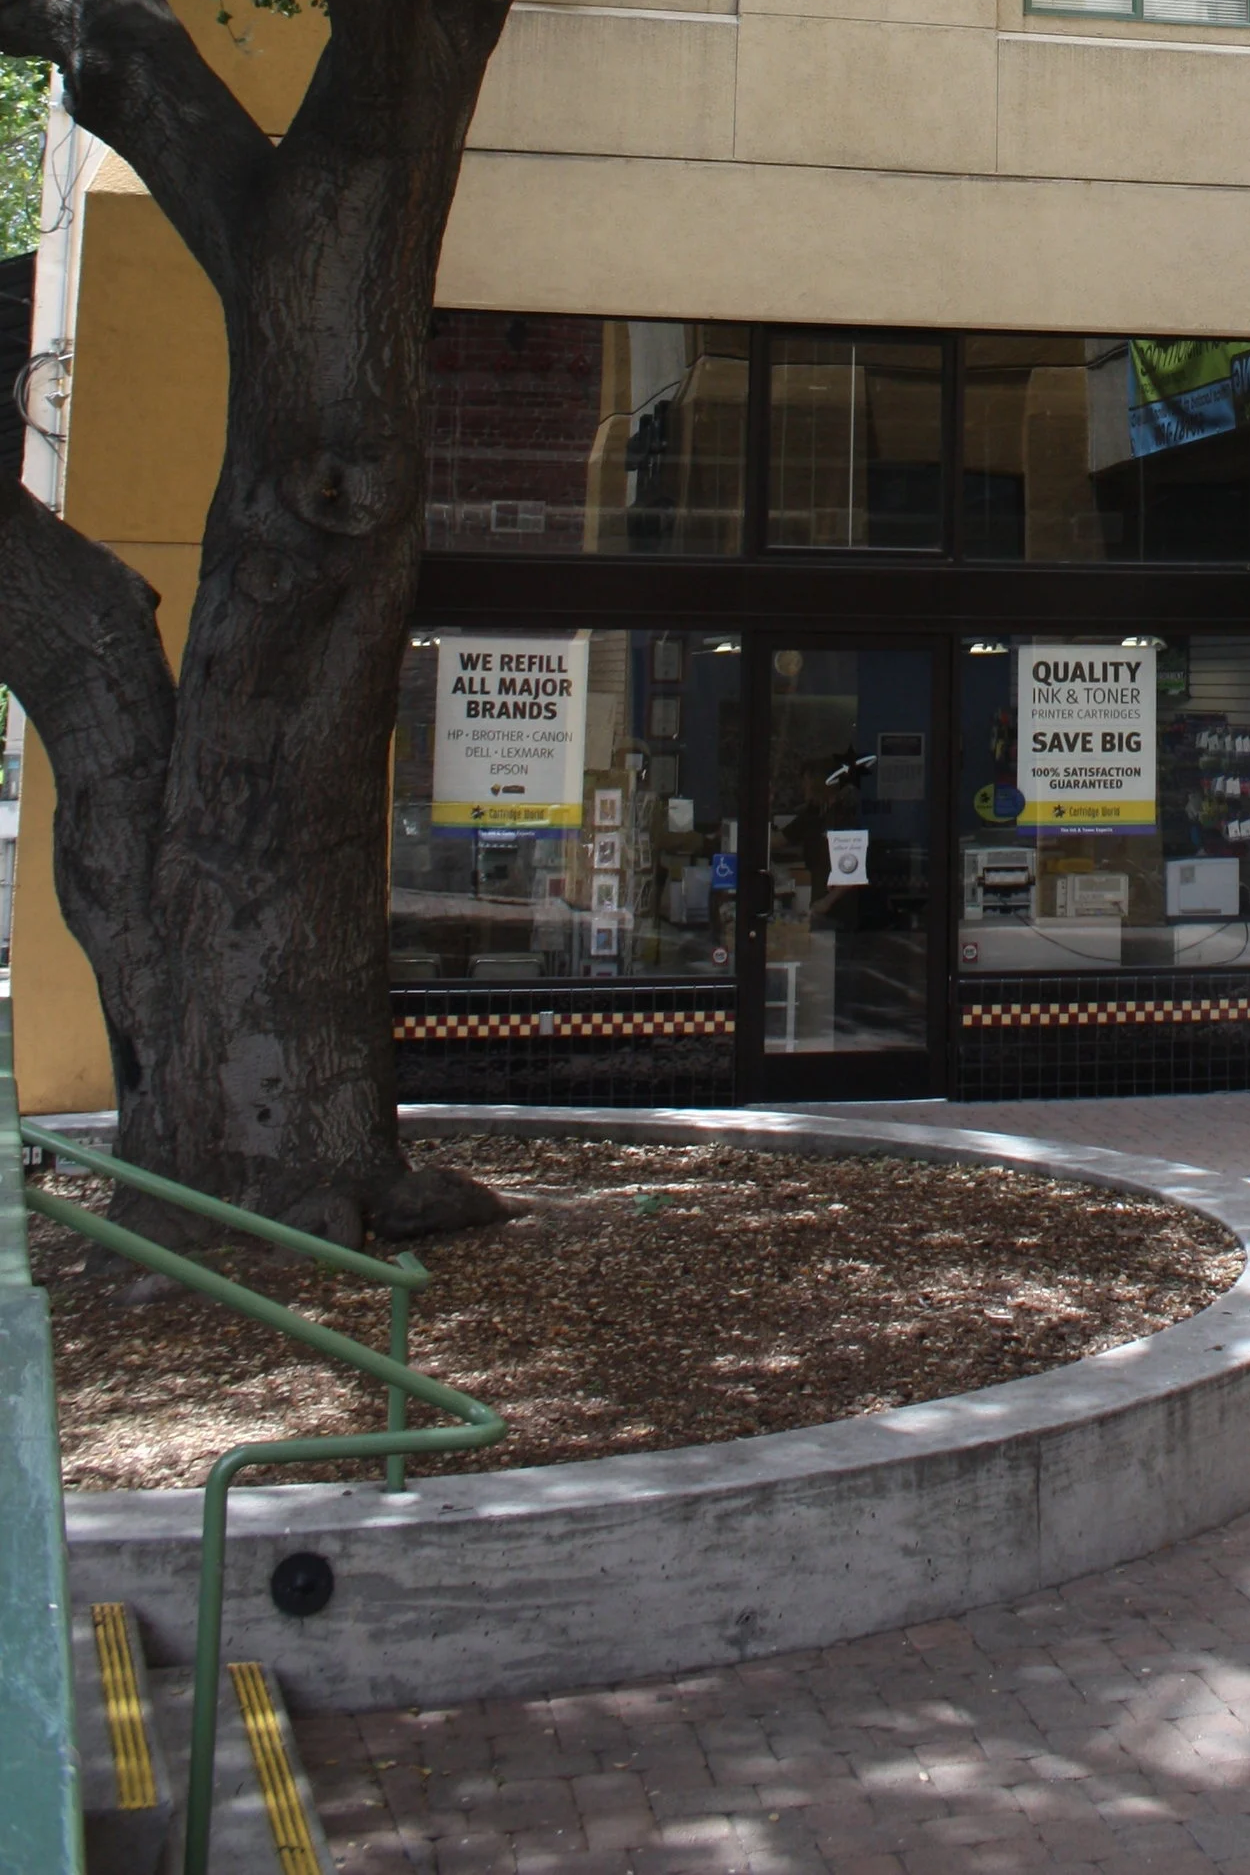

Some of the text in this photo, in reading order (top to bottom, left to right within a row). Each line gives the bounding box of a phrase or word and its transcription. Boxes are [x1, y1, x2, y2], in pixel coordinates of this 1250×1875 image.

[459, 652, 568, 673] WE REFILL
[1032, 660, 1142, 686] QUALITY
[451, 675, 573, 701] ALL MAJOR
[1032, 687, 1141, 704] INK & TONER
[466, 700, 558, 721] BRANDS
[1031, 708, 1141, 719] PRINTER CARTRIDGES
[447, 728, 573, 743] HP BROTHER CANON
[1031, 731, 1142, 753] SAVE BIG
[465, 746, 555, 759] DELL LEXMARK
[489, 763, 528, 775] EPSON
[1031, 766, 1142, 778] 100% SATISFACTION
[1049, 778, 1123, 790] GUARANTEED
[1068, 805, 1100, 819] Cartridge
